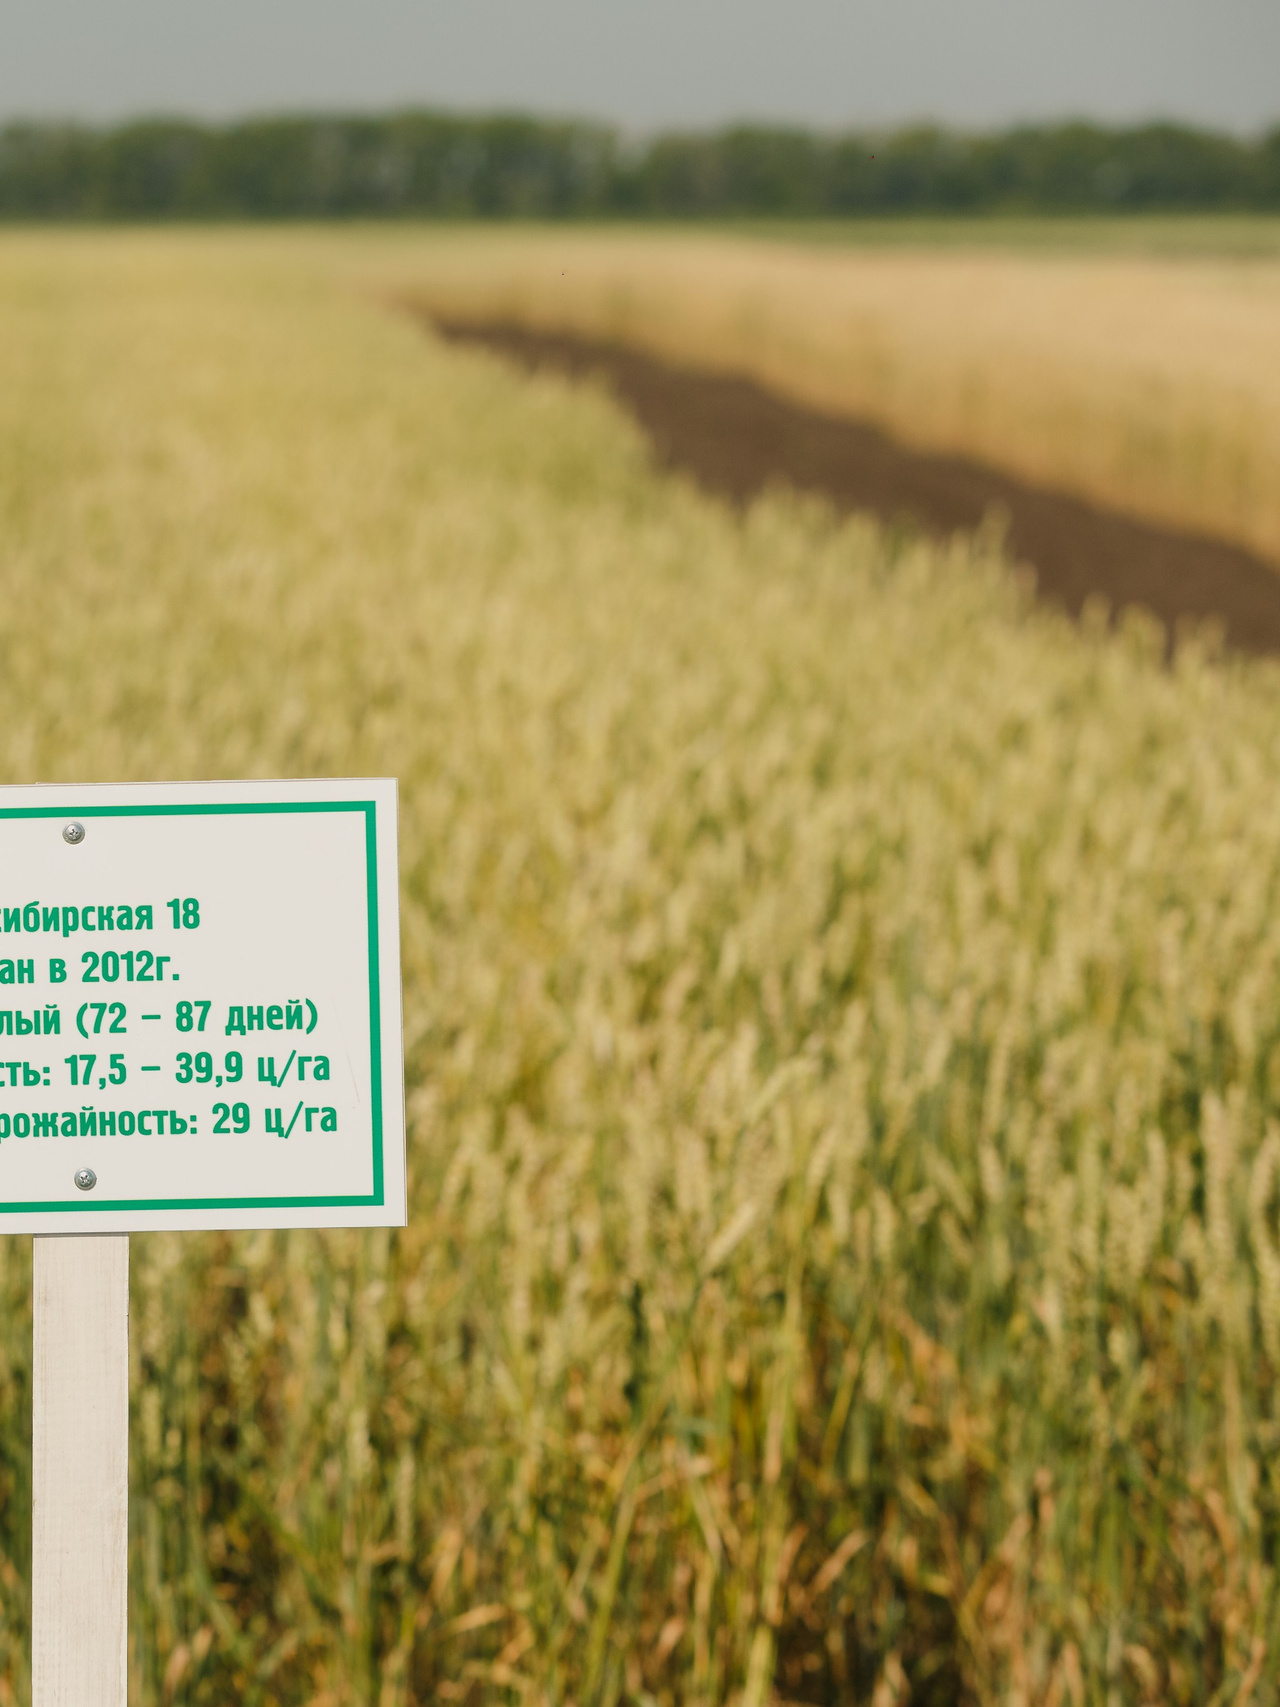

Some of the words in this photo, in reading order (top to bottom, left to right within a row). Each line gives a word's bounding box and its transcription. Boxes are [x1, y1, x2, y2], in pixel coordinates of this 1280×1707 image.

[166, 897, 201, 930] 18
[48, 957, 68, 984] в
[80, 949, 180, 984] 2012г.
[75, 1001, 128, 1040] (72
[175, 1000, 213, 1033] 87
[224, 997, 319, 1036] дней)
[64, 1053, 127, 1091] 17,5
[174, 1050, 244, 1088] 39,9
[257, 1049, 331, 1088] ц/га
[211, 1101, 251, 1135] 29
[264, 1100, 338, 1140] ц/га
